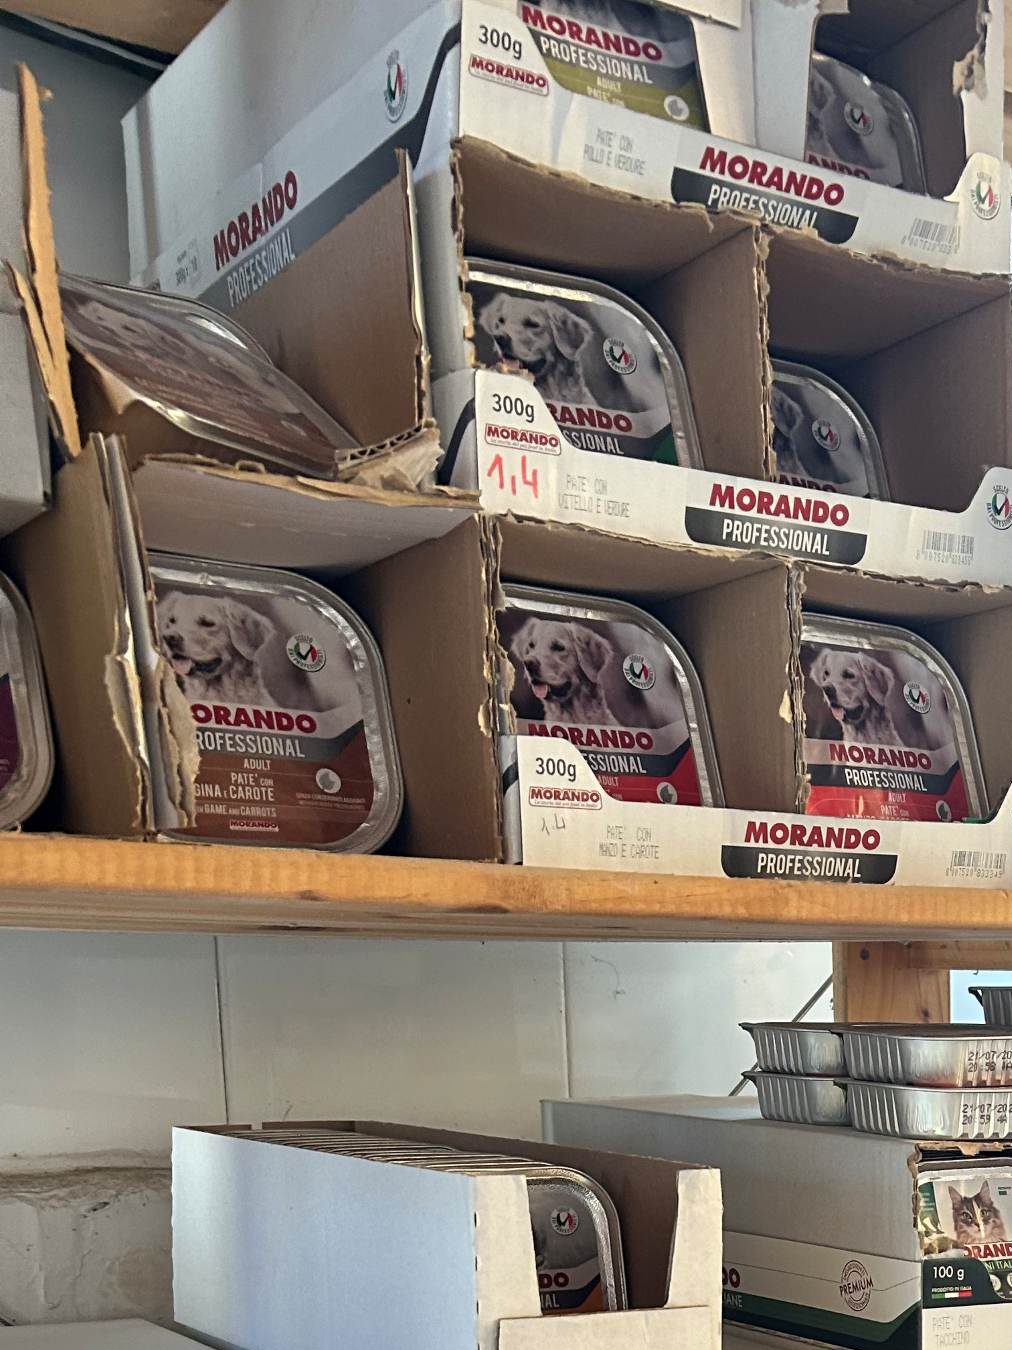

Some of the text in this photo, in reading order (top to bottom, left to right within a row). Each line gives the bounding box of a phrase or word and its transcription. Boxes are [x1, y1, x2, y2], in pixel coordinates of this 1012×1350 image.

[478, 25, 523, 60] 300g
[521, 5, 663, 62] MORANDO
[471, 56, 547, 88] MORANDO
[540, 35, 654, 84] PROFESSIONAL
[700, 146, 845, 207] MORANDO
[213, 170, 298, 271] MORANDO
[708, 184, 818, 229] PROFESSIONAL
[227, 226, 296, 308] PROFESSIONAL
[492, 393, 535, 424] 300g
[546, 403, 633, 433] RANDO
[487, 425, 559, 448] MORANDO
[563, 430, 624, 455] SSIONAL
[709, 483, 850, 527] MORANDO
[722, 519, 830, 556] PROFESSIONAL
[191, 703, 317, 734] ORANDO
[195, 731, 306, 758] ROFESSIONAL
[829, 743, 932, 770] MORANDO
[243, 759, 271, 769] ADULT
[535, 757, 577, 782] 300g
[229, 786, 275, 801] CAROTE
[844, 767, 928, 792] PROFESSIONAL
[531, 788, 601, 804] MORANDO
[230, 819, 278, 830] MORANDO
[744, 820, 881, 851] MORANDO
[757, 852, 862, 878] PROFESSIONAL
[839, 1277, 874, 1297] PREMIUM
[933, 1266, 965, 1281] 100 g
